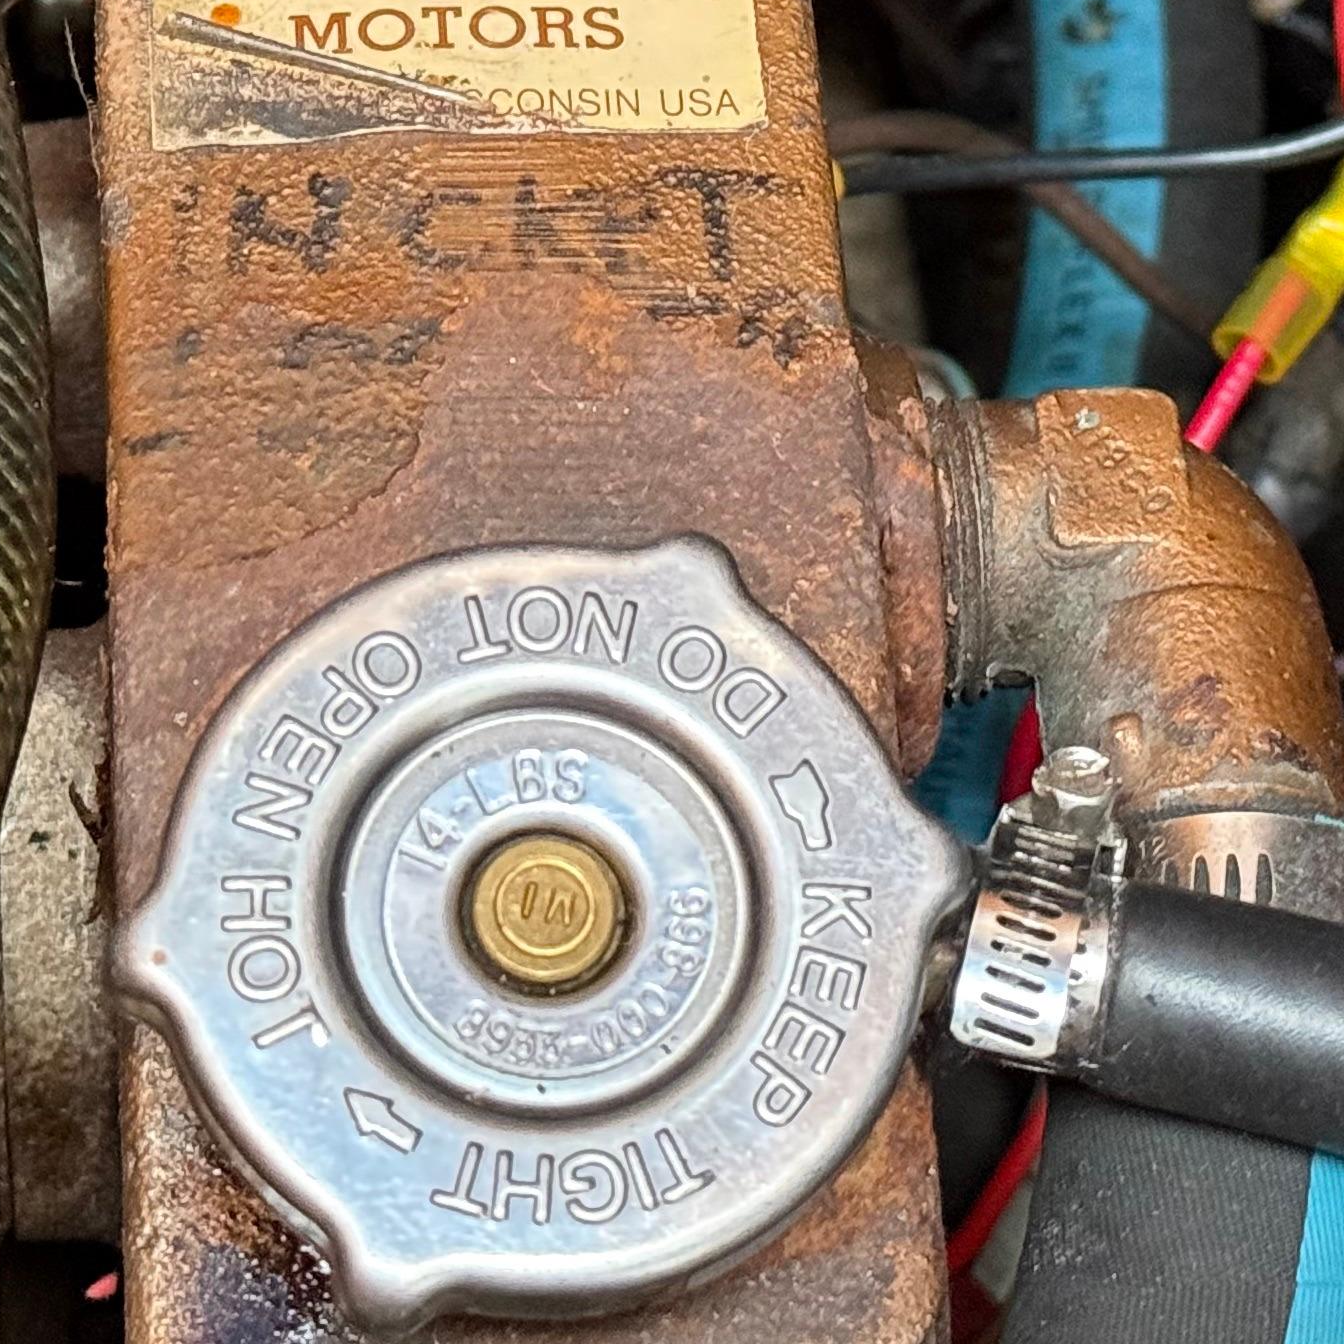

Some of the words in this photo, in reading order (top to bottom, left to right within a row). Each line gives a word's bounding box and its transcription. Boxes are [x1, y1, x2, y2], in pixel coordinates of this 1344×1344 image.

[287, 5, 625, 55] MOTORS
[465, 88, 641, 117] CONSIN
[659, 87, 740, 117] USA
[458, 584, 639, 665] NOT
[234, 629, 423, 841] OPEN
[659, 623, 789, 739] DO
[219, 873, 332, 1050] HOT
[750, 881, 873, 1129] KEEP
[431, 1125, 716, 1226] TIGHT
